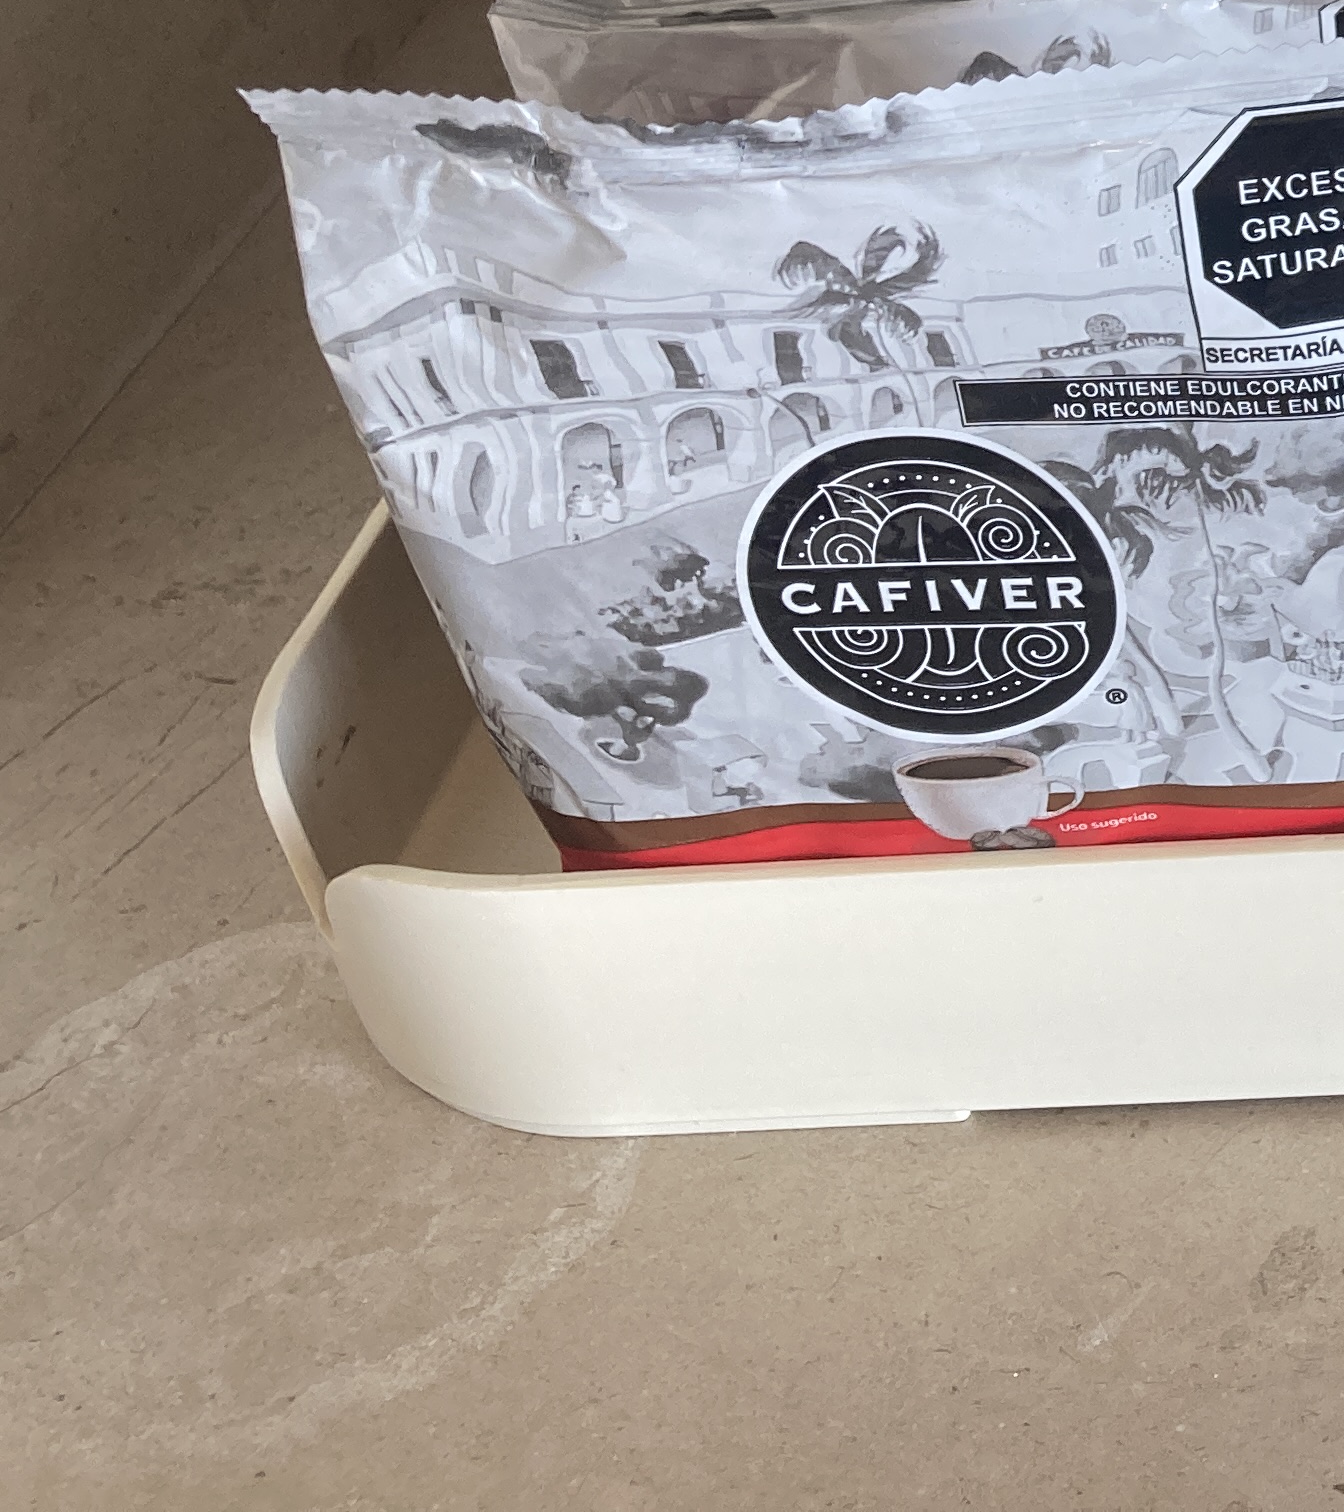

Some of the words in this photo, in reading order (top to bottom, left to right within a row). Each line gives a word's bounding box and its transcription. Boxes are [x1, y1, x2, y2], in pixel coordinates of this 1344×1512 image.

[1115, 336, 1177, 352] CALIDAD
[1065, 380, 1181, 399] CONTIENE
[1053, 402, 1087, 420] NO
[1092, 399, 1282, 419] RECOMENDABLE
[1287, 397, 1319, 415] EN
[780, 575, 1087, 616] CAFIVER
[1059, 821, 1089, 834] Uso
[1091, 810, 1159, 833] sugerido
